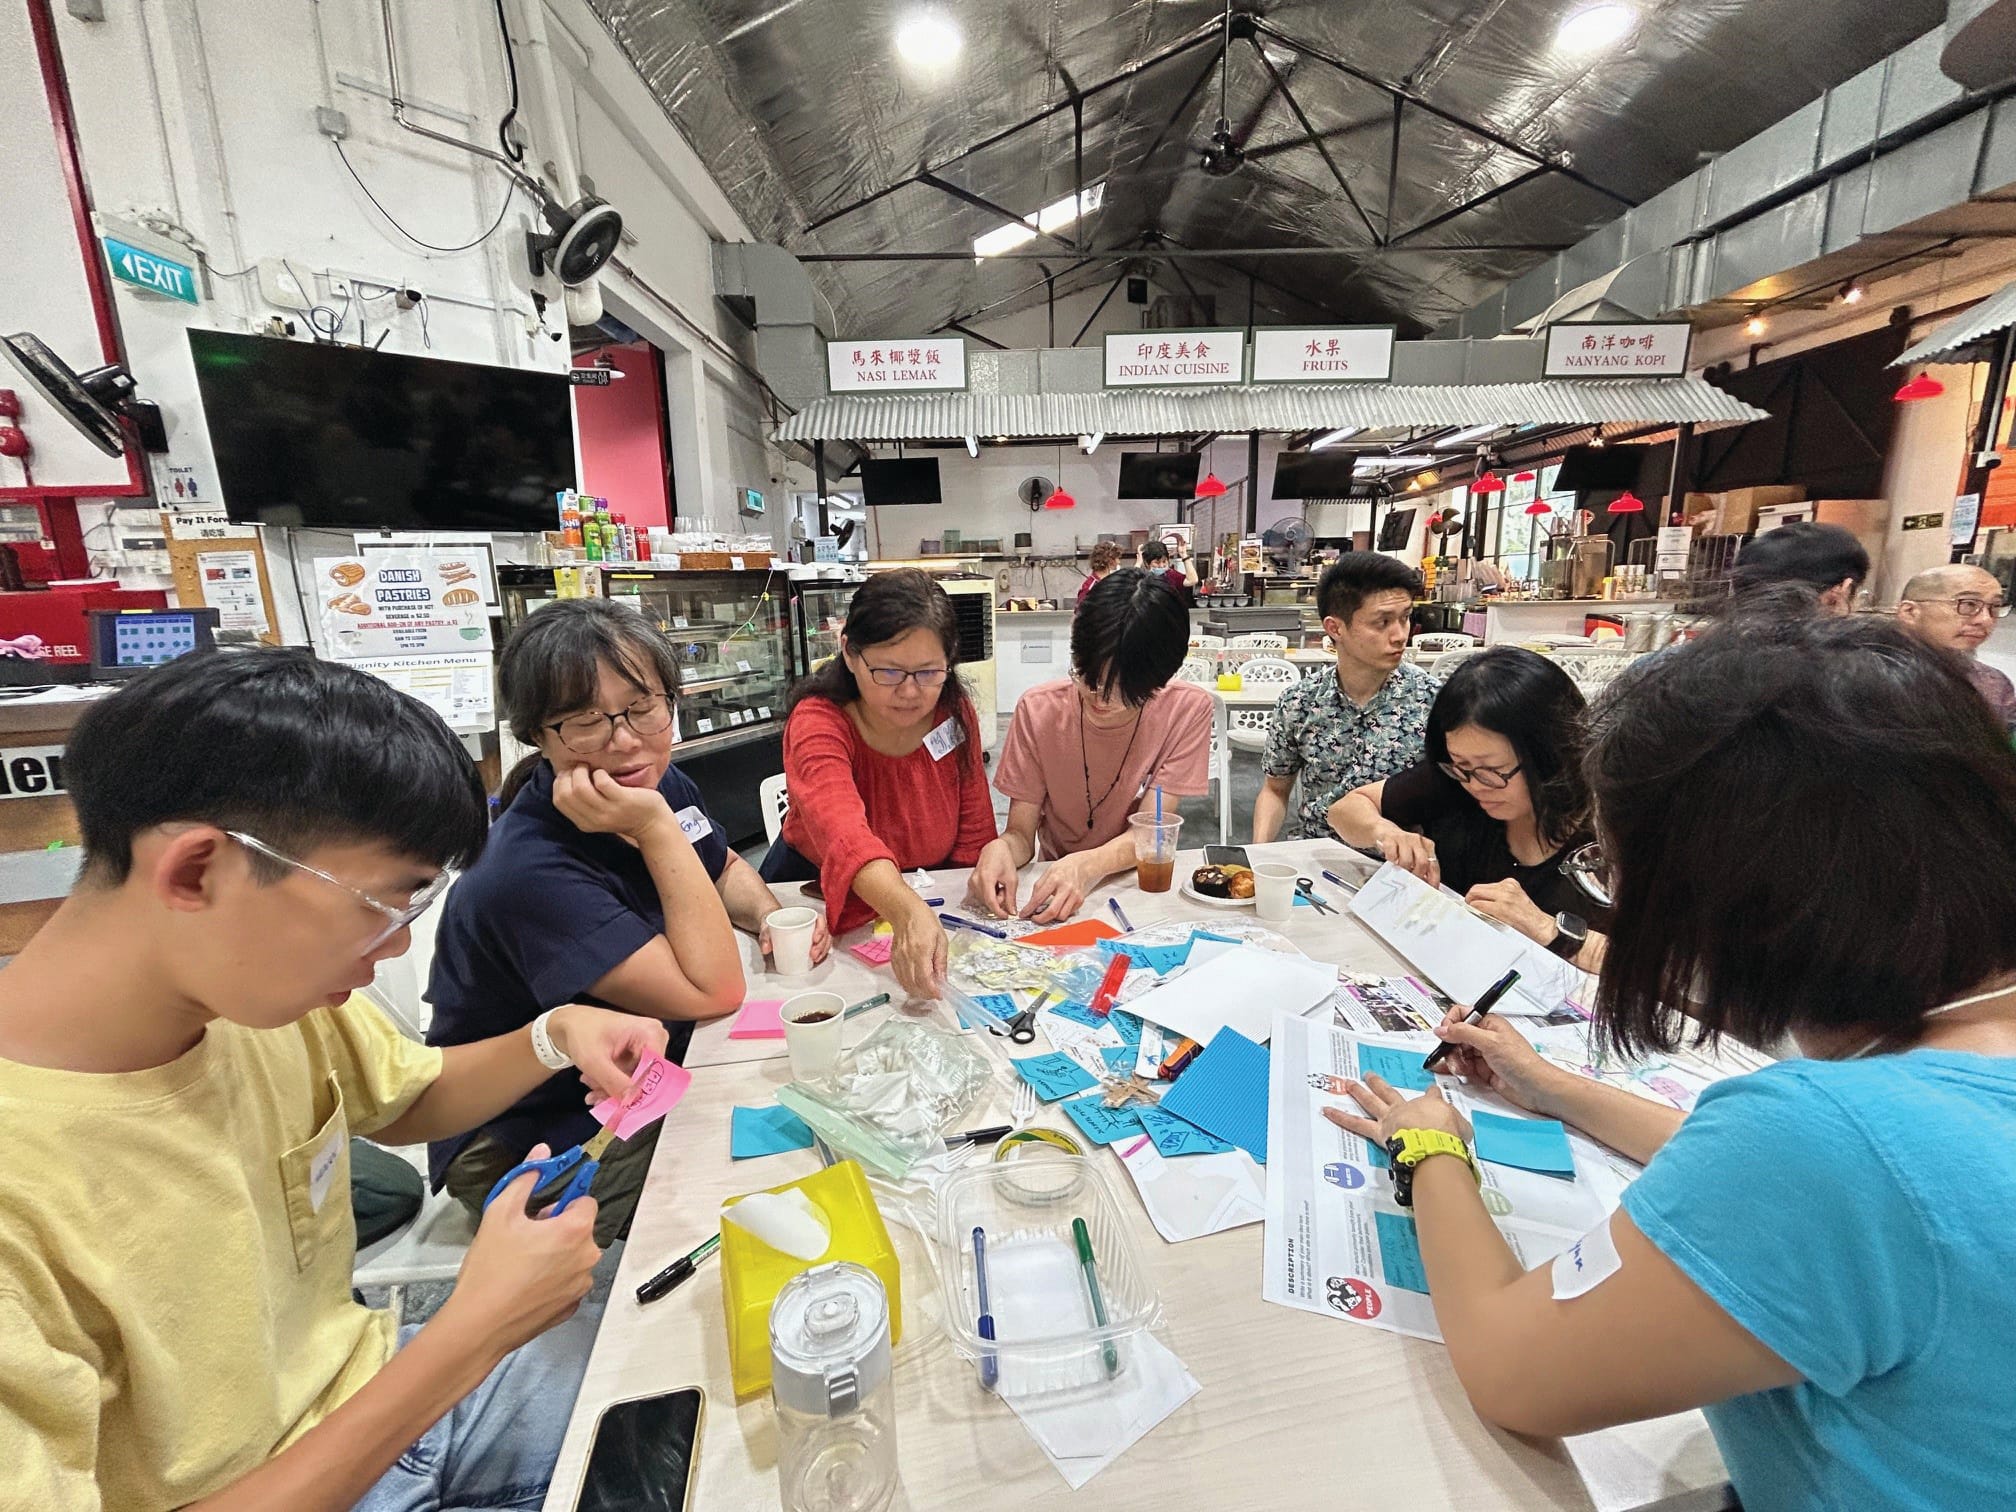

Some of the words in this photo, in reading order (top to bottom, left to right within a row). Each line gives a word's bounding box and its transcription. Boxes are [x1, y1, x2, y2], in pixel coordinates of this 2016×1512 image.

[133, 254, 184, 295] EXIT
[1305, 339, 1341, 357] 水果
[1581, 334, 1656, 350] 南洋咖啡
[852, 348, 941, 366] 馬來椰漿飯
[1137, 340, 1211, 360] 印度美食
[1303, 360, 1349, 371] FRUITS
[1565, 355, 1630, 366] NANYANG
[1634, 354, 1667, 366] KOPI
[857, 370, 887, 382] NASI
[893, 369, 937, 381] LEMAK
[1118, 364, 1169, 377] INDIAN
[1174, 362, 1230, 375] CUISINE
[176, 517, 193, 526] Pay
[379, 569, 422, 582] DANISH
[375, 588, 431, 602] PASTRIES
[54, 645, 82, 657] REEL
[393, 658, 441, 667] Kitchen
[1287, 1237, 1295, 1294] DESCRIPTION
[1364, 1288, 1375, 1316] PEOPLE
